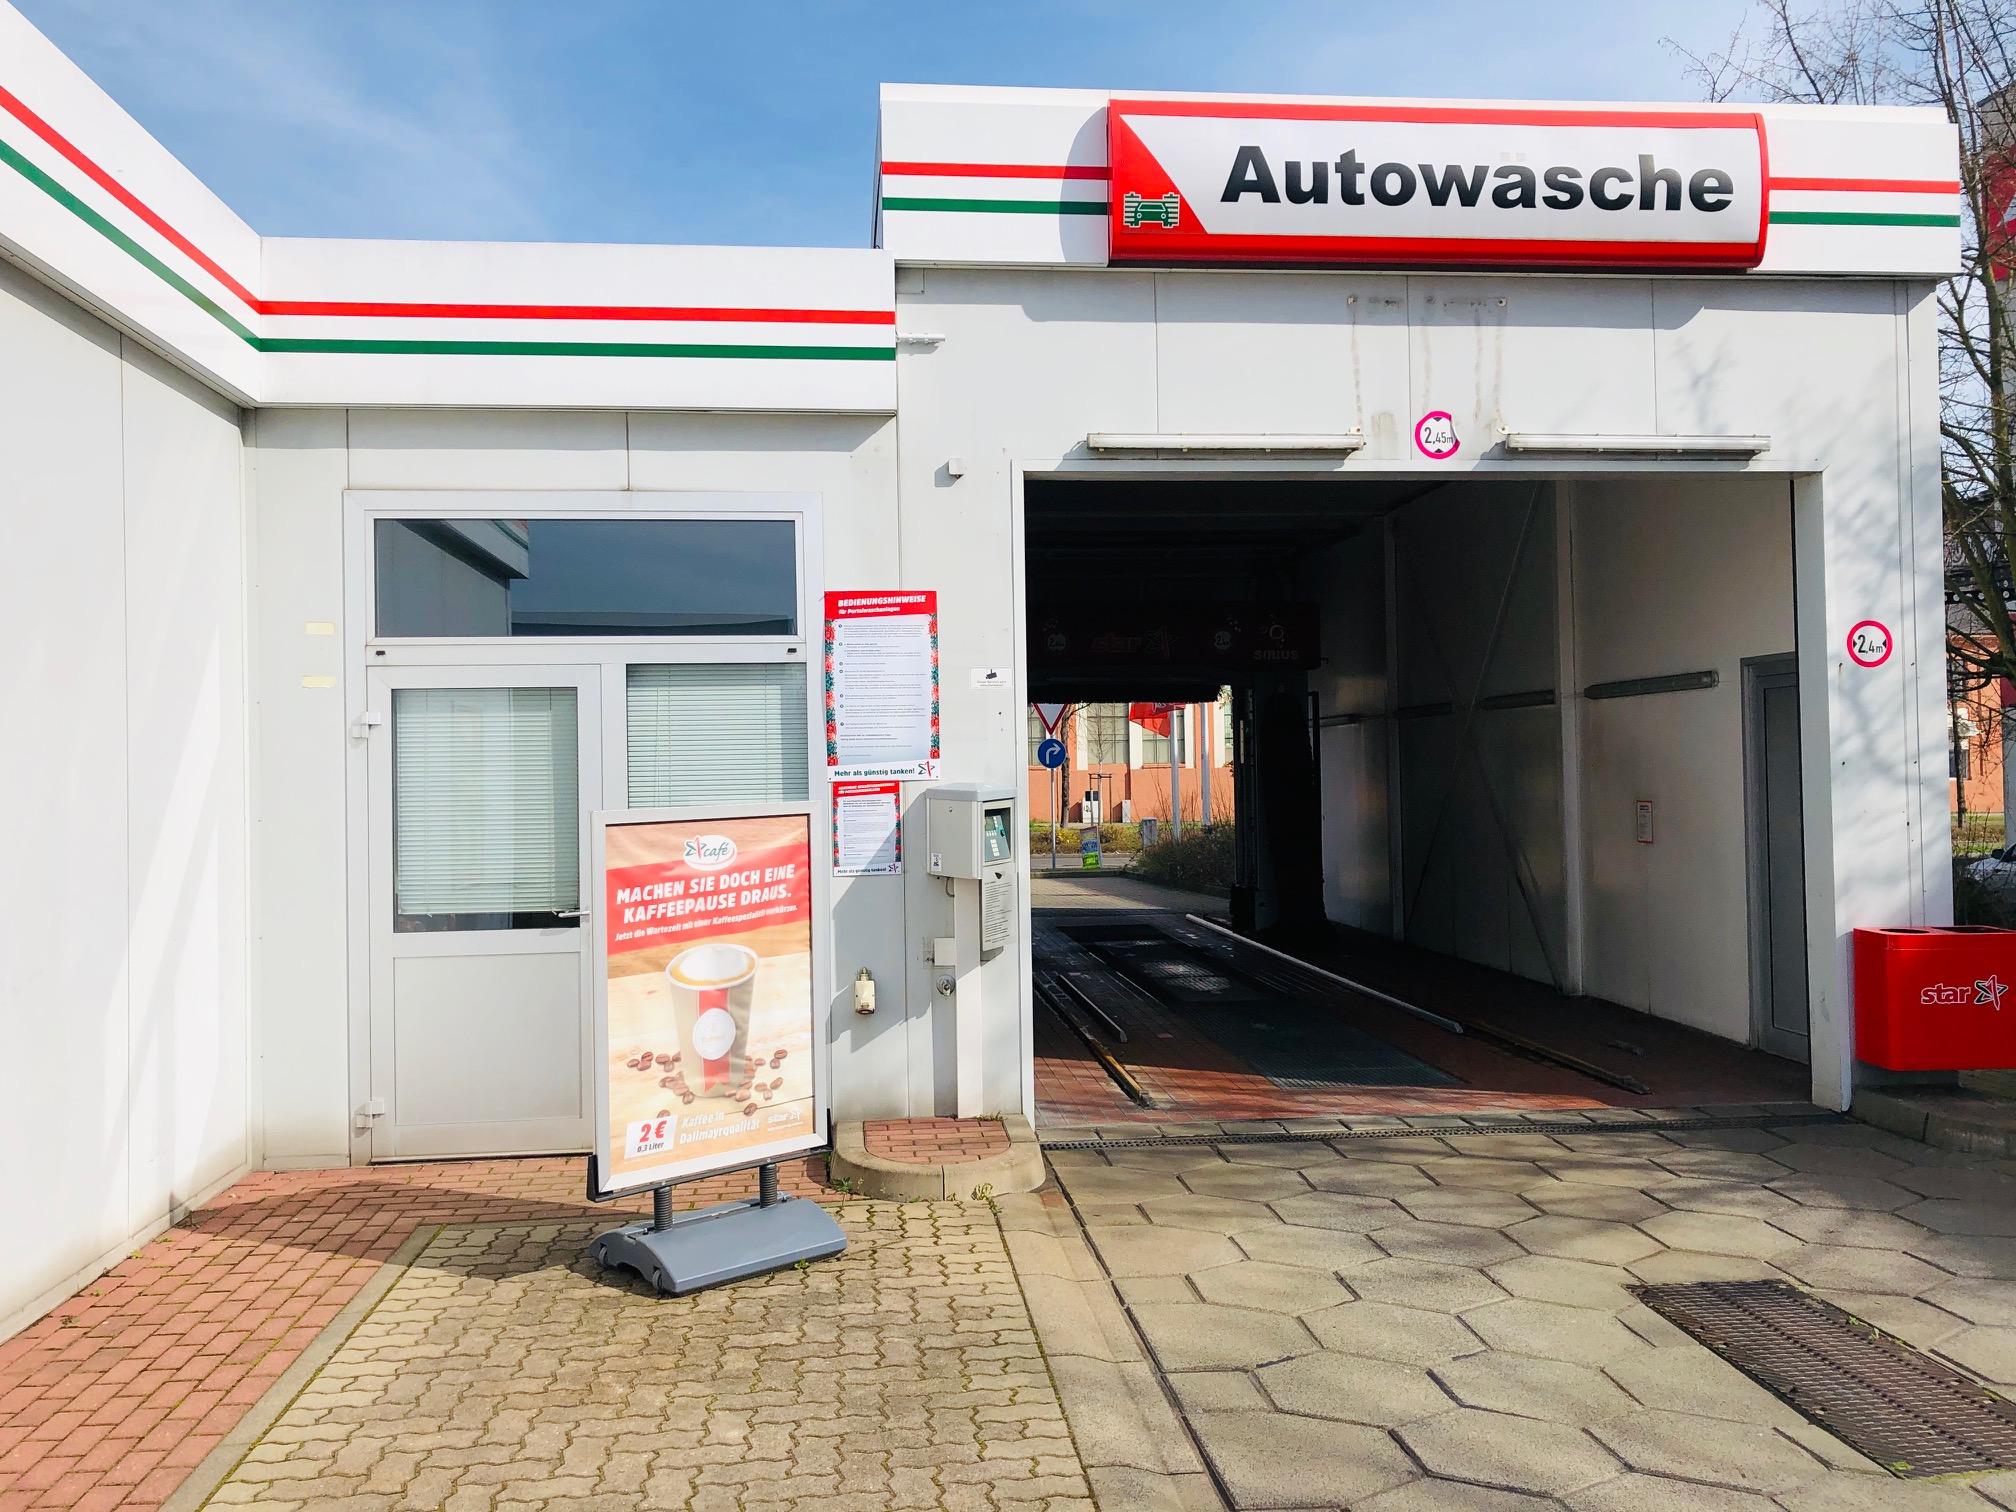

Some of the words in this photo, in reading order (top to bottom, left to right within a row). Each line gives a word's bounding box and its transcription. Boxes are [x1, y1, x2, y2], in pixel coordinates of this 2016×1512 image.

[1220, 145, 1734, 213] Autowäsche
[1424, 427, 1454, 445] 2,45m
[838, 595, 926, 607] BEDIENUNGSHINWEISE
[1857, 634, 1884, 654] 2,4m
[1254, 649, 1299, 660] SIRIUS
[864, 769, 888, 777] günstig
[703, 842, 730, 862] café
[616, 880, 685, 905] MACHEN
[689, 876, 715, 894] SIE
[720, 869, 760, 890] DOCH
[765, 864, 796, 883] EINE
[623, 892, 737, 924] KAFFEEPAUSE
[740, 883, 792, 906] DRAUS.
[615, 931, 633, 942] Jetzt
[634, 928, 646, 938] die
[646, 924, 682, 936] Wartezeit
[682, 921, 694, 930] mit
[1921, 983, 1971, 1005] star
[681, 1114, 714, 1128] Kaffee
[639, 1123, 652, 1143] 2
[654, 1120, 667, 1139] €
[679, 1119, 760, 1145] Dallmayrqualität
[648, 1141, 664, 1151] Liter
